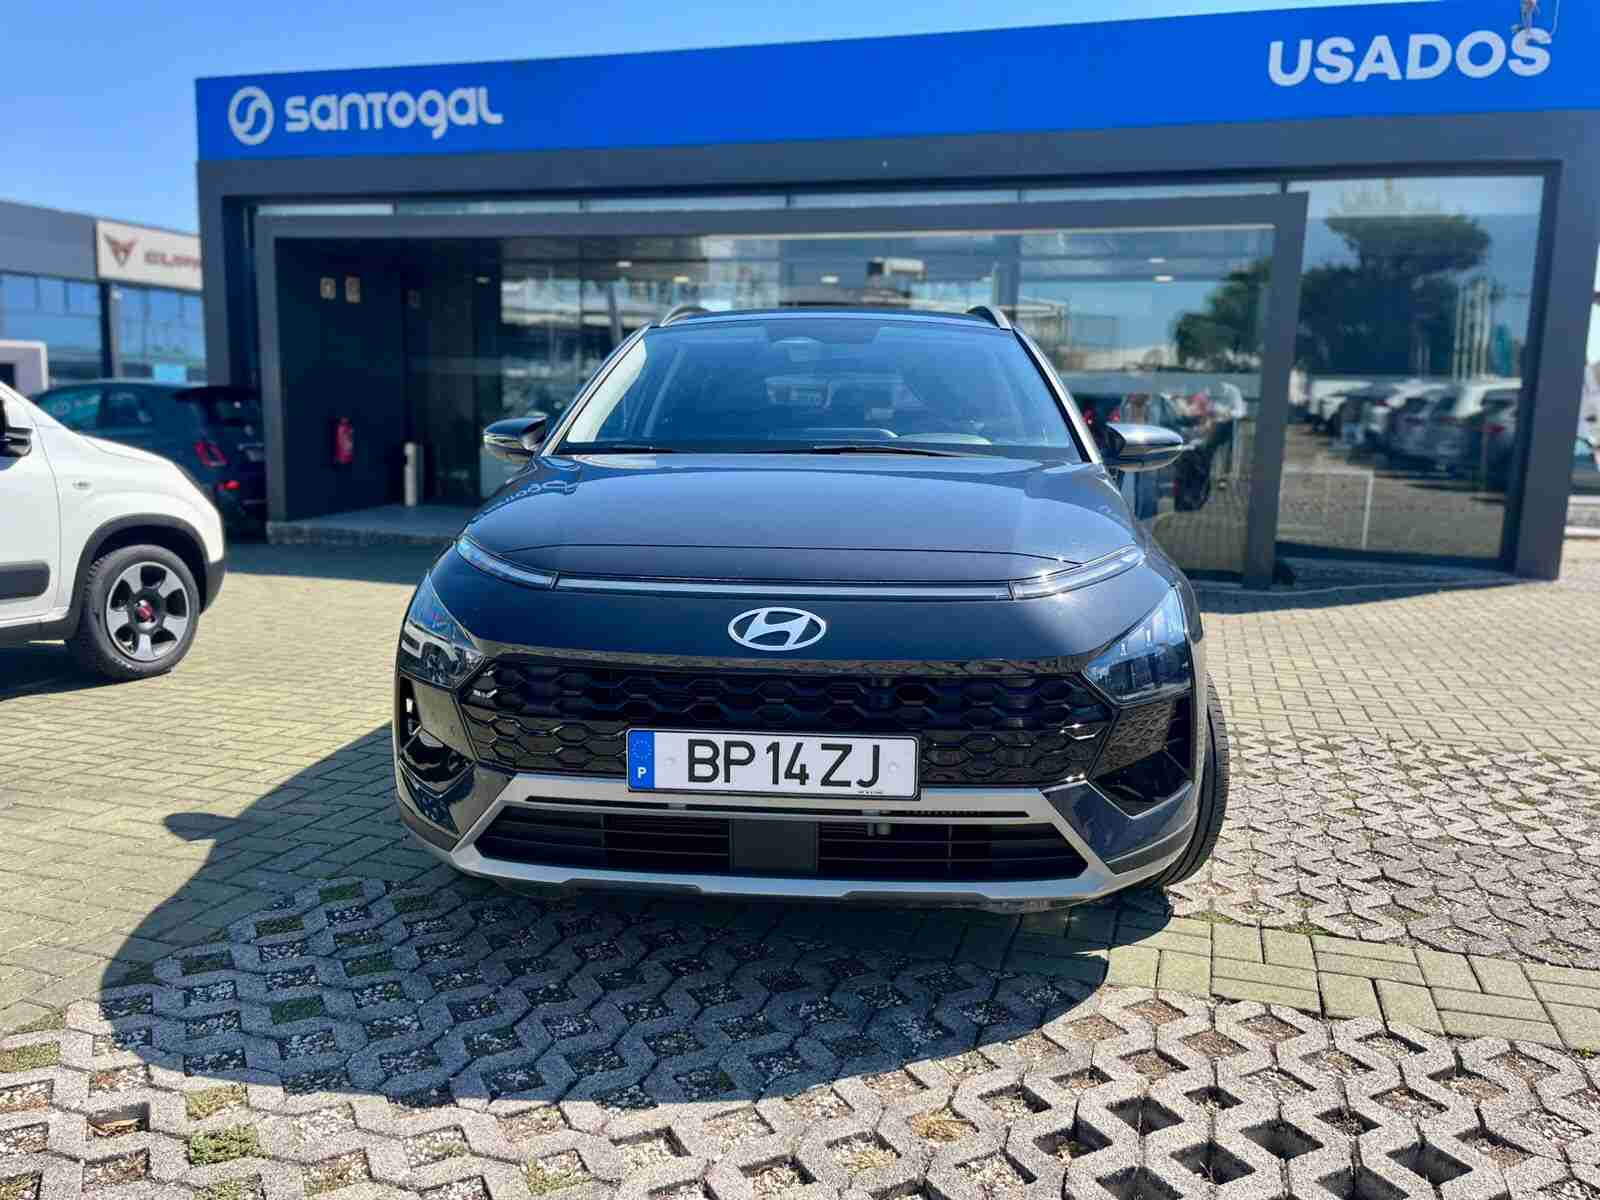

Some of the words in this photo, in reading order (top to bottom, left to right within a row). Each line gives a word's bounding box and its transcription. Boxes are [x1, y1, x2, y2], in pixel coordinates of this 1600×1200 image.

[1268, 27, 1552, 87] USADOS
[637, 766, 648, 779] P
[687, 738, 755, 784] BP
[766, 741, 810, 786] 14
[820, 743, 881, 788] ZJ
